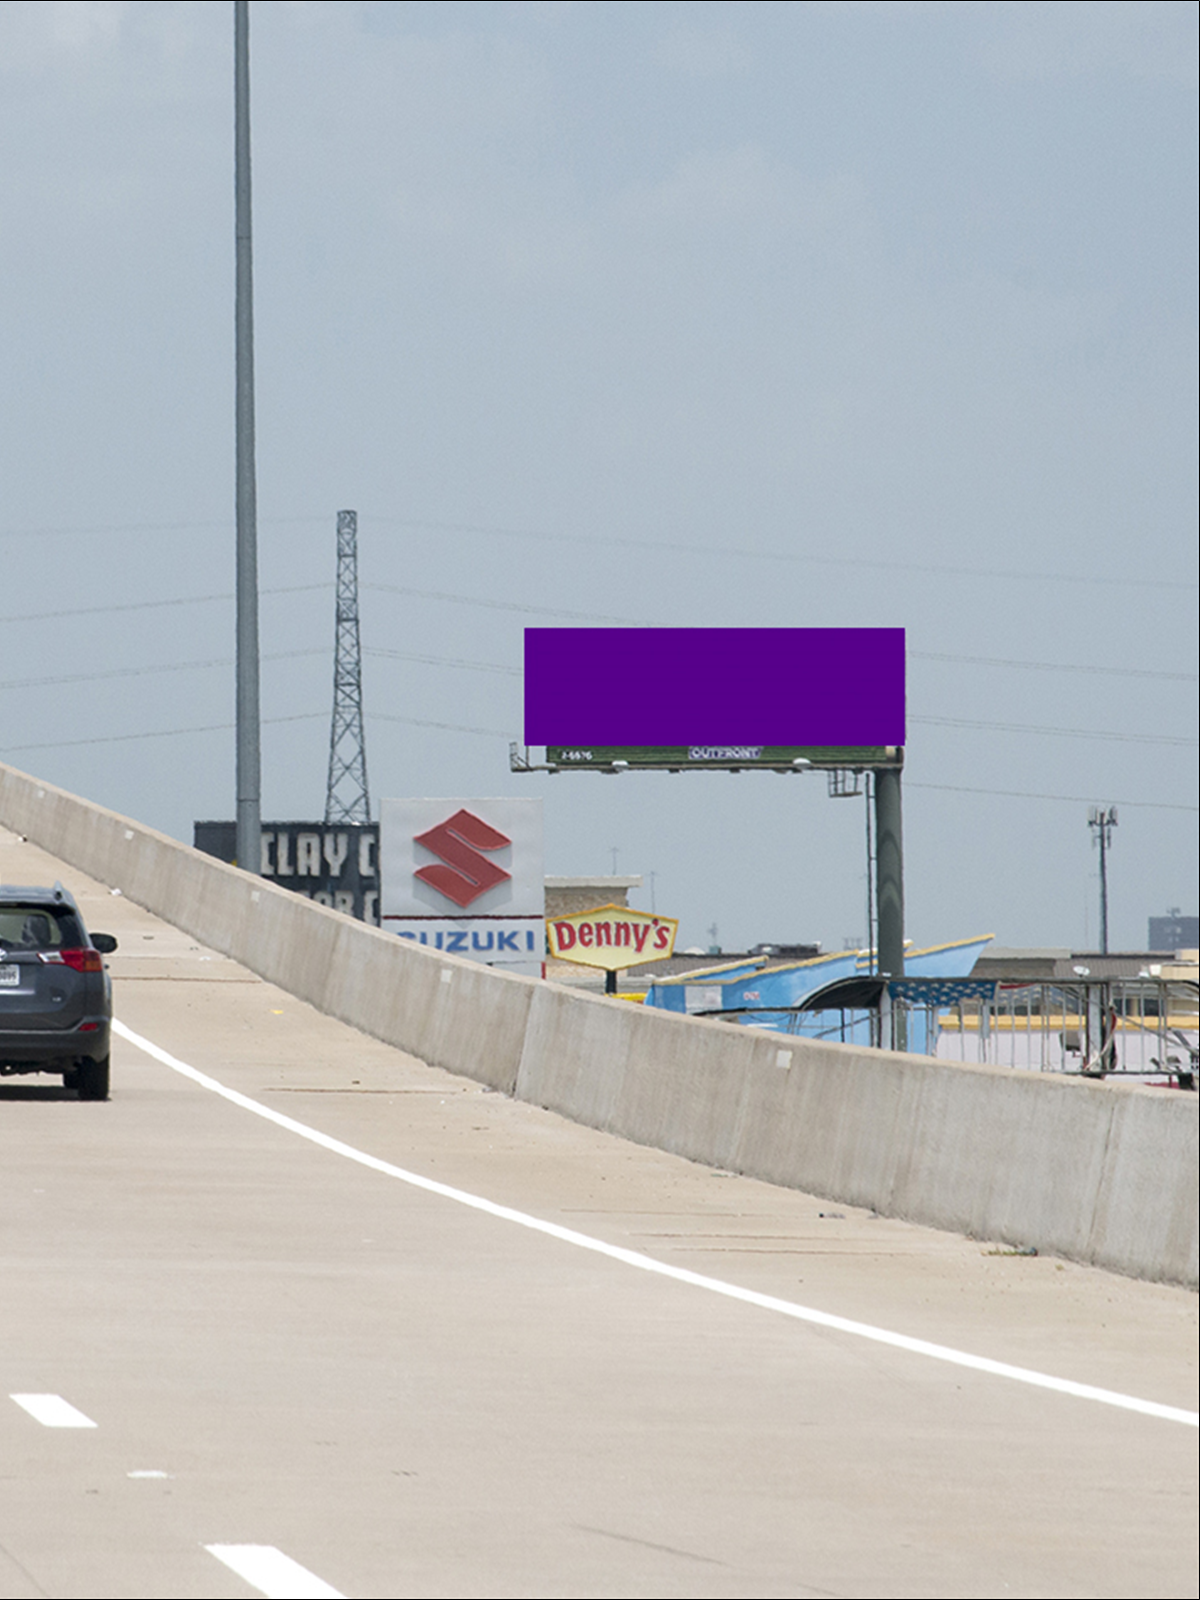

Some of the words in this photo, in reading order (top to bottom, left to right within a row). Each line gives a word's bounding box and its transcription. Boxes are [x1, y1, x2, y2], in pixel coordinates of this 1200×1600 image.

[690, 747, 761, 759] OUTFRONT
[261, 832, 348, 876] CLAY
[554, 918, 670, 953] Denny's
